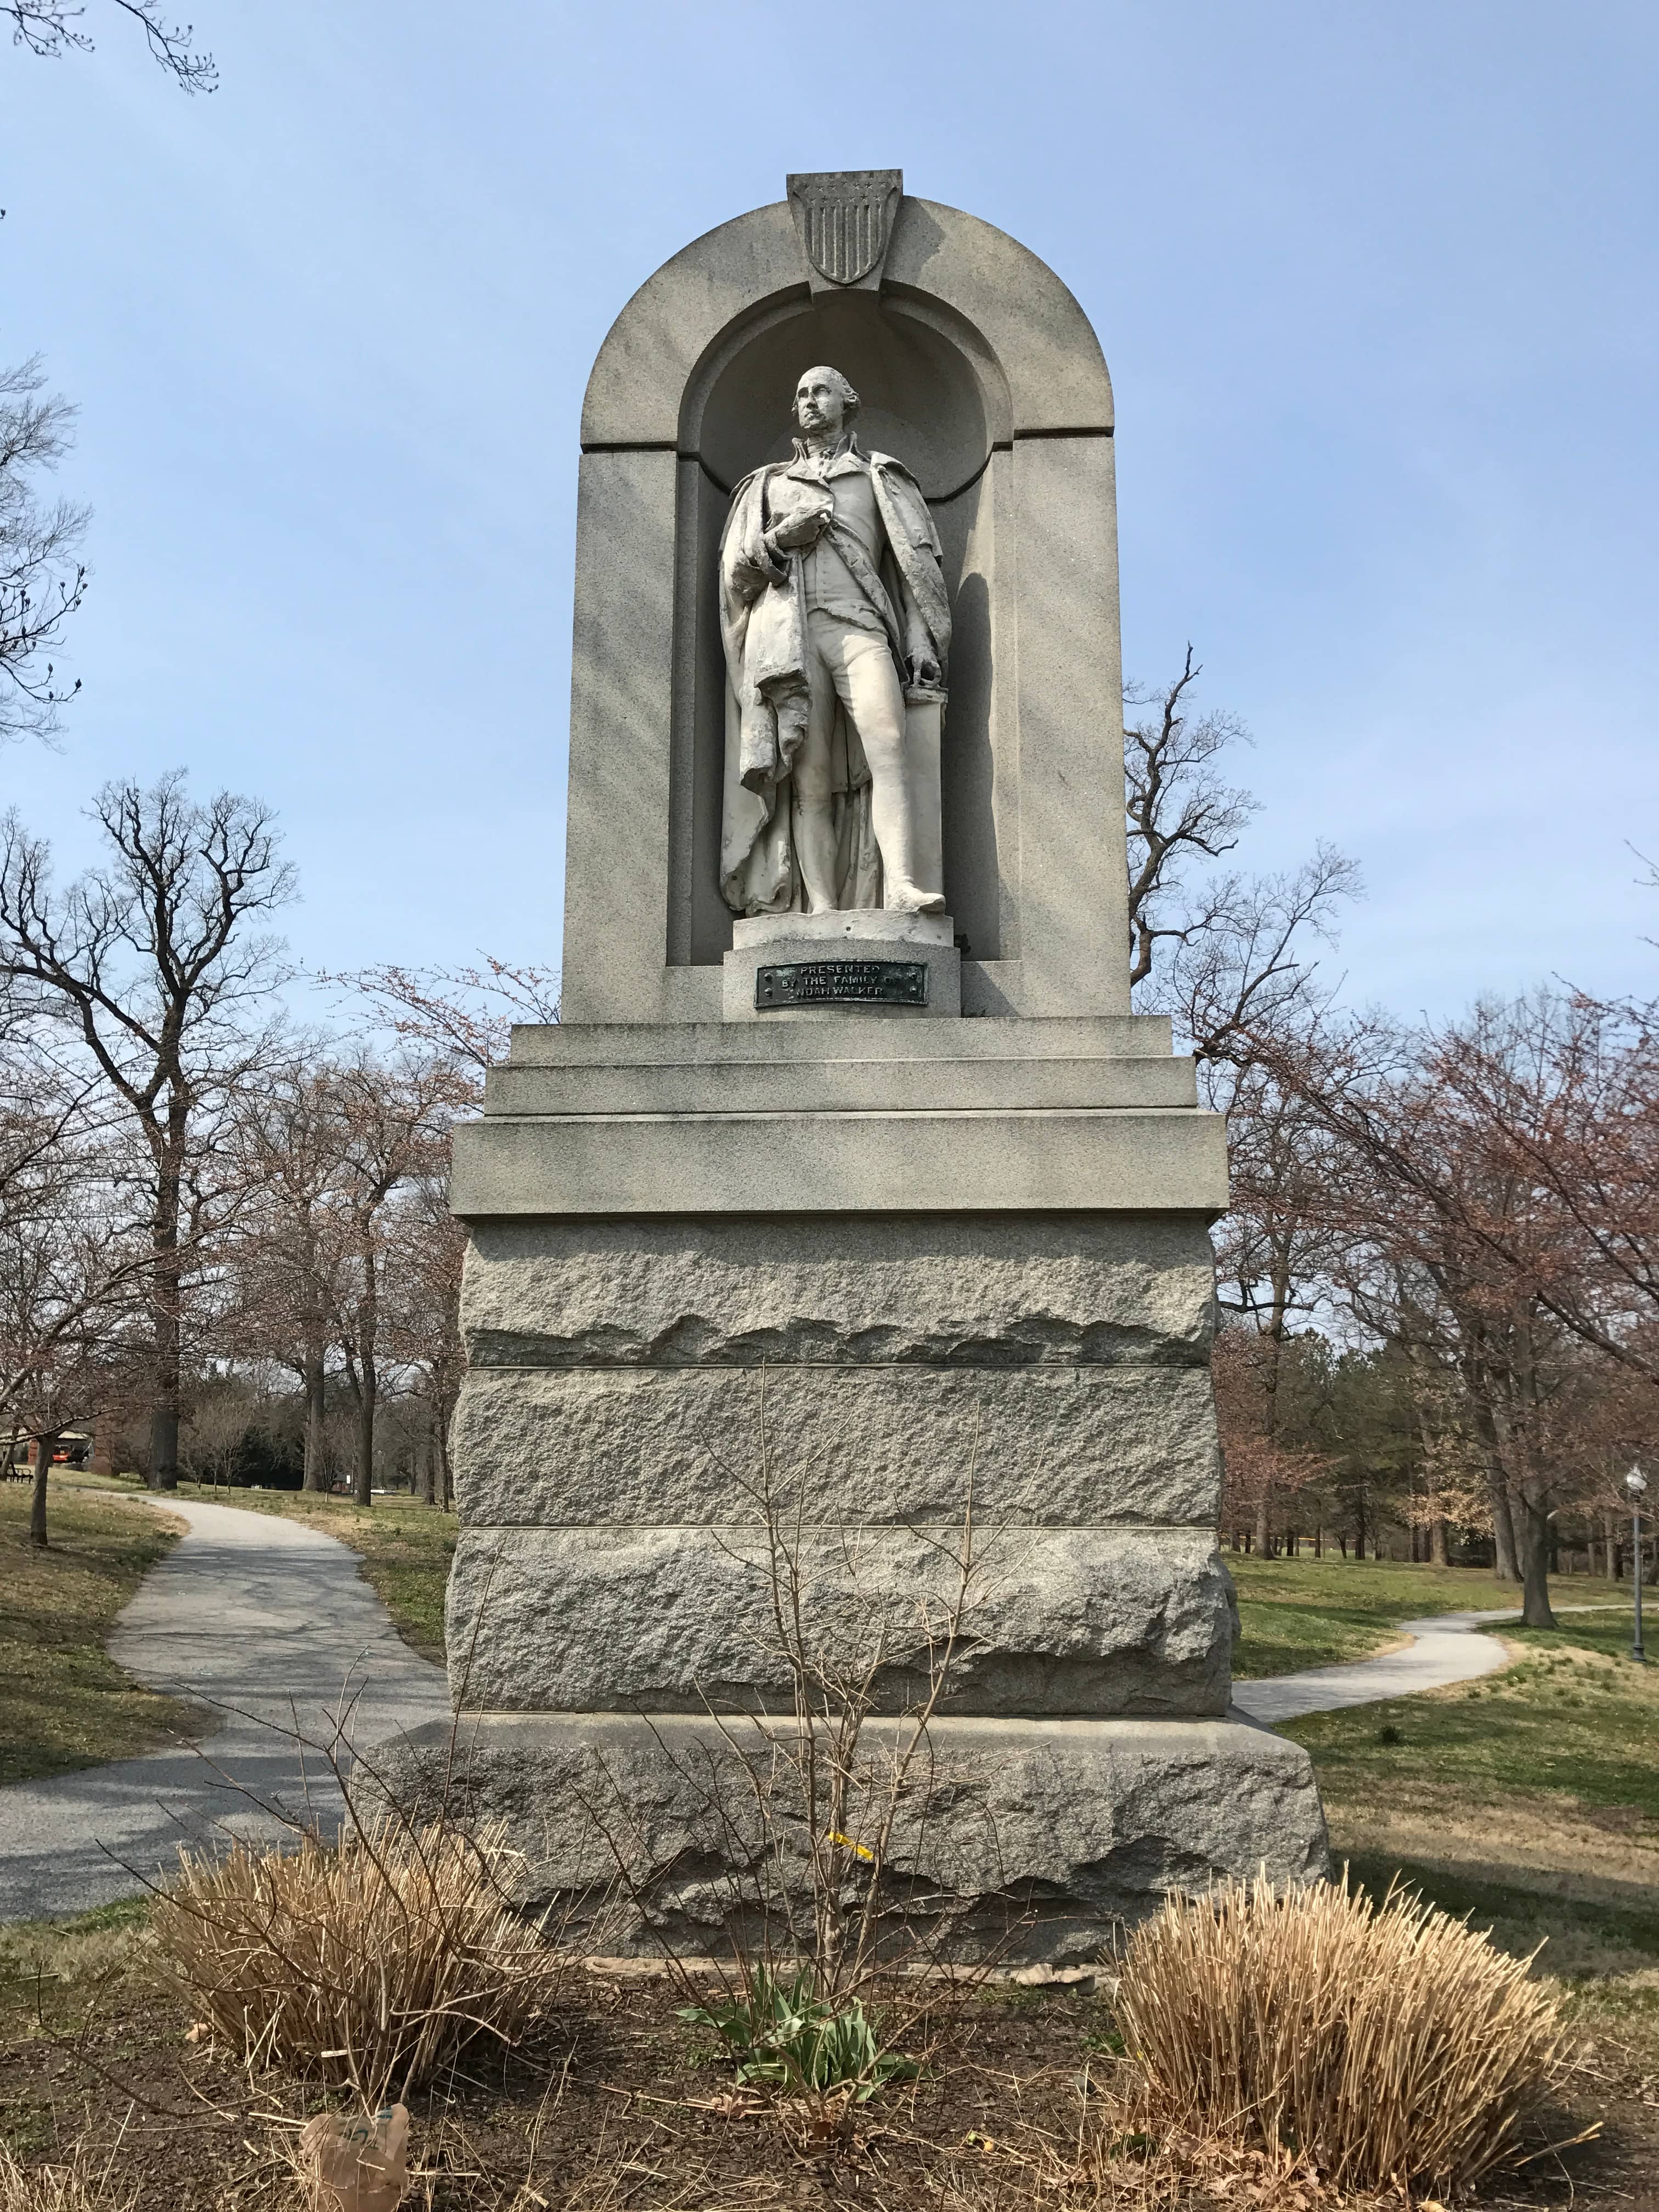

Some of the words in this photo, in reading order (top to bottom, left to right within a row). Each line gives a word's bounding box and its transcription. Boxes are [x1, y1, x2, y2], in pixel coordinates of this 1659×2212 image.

[800, 965, 880, 974] PRESENTED
[782, 979, 798, 989] BY
[803, 977, 827, 985] THE
[834, 975, 878, 985] FAMILY
[883, 977, 898, 986] OF
[797, 987, 831, 996] NOAH
[833, 986, 883, 996] WALKER
